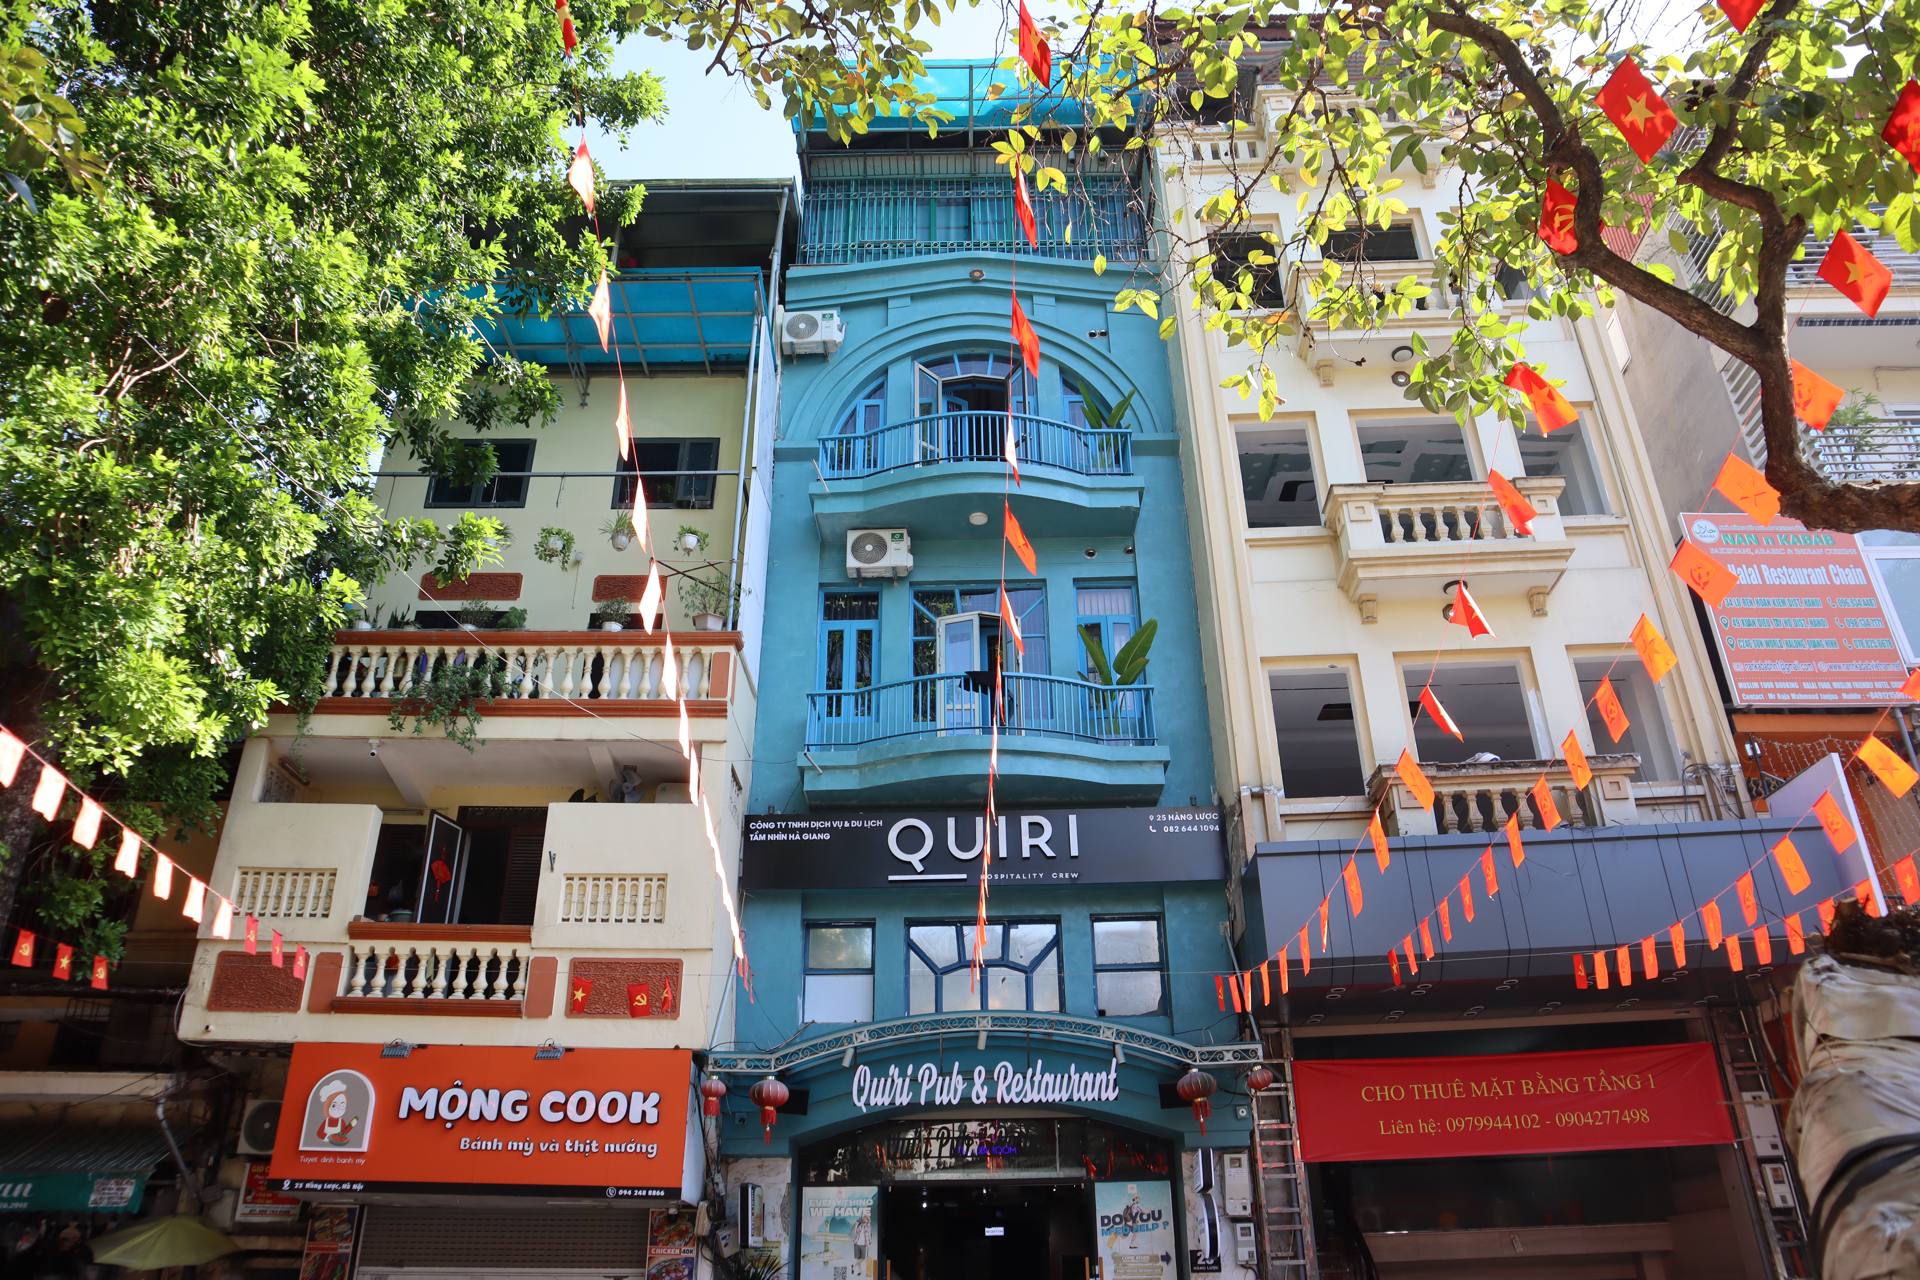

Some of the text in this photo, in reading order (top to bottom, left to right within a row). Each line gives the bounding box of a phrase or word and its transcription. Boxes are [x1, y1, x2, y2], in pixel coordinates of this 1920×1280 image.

[1722, 533, 1760, 546] NAN
[1728, 563, 1867, 585] Halal Restaurant Chain
[1156, 812, 1219, 822] 25 HÀNG LƯỢC
[750, 819, 883, 830] CÔNG TY TNHH DỊCH VỤ & DU LỊCH
[1163, 825, 1179, 833] 082
[1199, 824, 1220, 832] 1094
[767, 832, 788, 841] NHÌN
[789, 831, 801, 841] HÀ
[802, 832, 830, 841] GIANG
[887, 814, 1079, 873] QUIRI
[852, 1057, 1119, 1113] Quiri Pub & Restaurant
[1361, 1069, 1656, 1102] CHO THUÊ MẶT BẰNG TẦNG 1
[398, 1080, 661, 1129] MỘNG COOK
[1379, 1118, 1415, 1136] Liên
[1417, 1116, 1442, 1137] hệ:
[1446, 1112, 1541, 1134] 0979944102
[1555, 1107, 1650, 1129] 0904277498
[460, 1136, 658, 1159] Bánh mỳ và thịt nướng
[305, 1180, 322, 1191] Hàng
[342, 1181, 351, 1189] Hà
[618, 1189, 632, 1197] 094
[808, 1198, 873, 1207] EVERYTHING
[810, 1206, 872, 1217] WE HAVE
[1100, 1208, 1163, 1228] DO YOU
[1134, 1222, 1160, 1234] HELP
[1162, 1220, 1170, 1231] ?
[650, 1247, 680, 1255] CHICKEN
